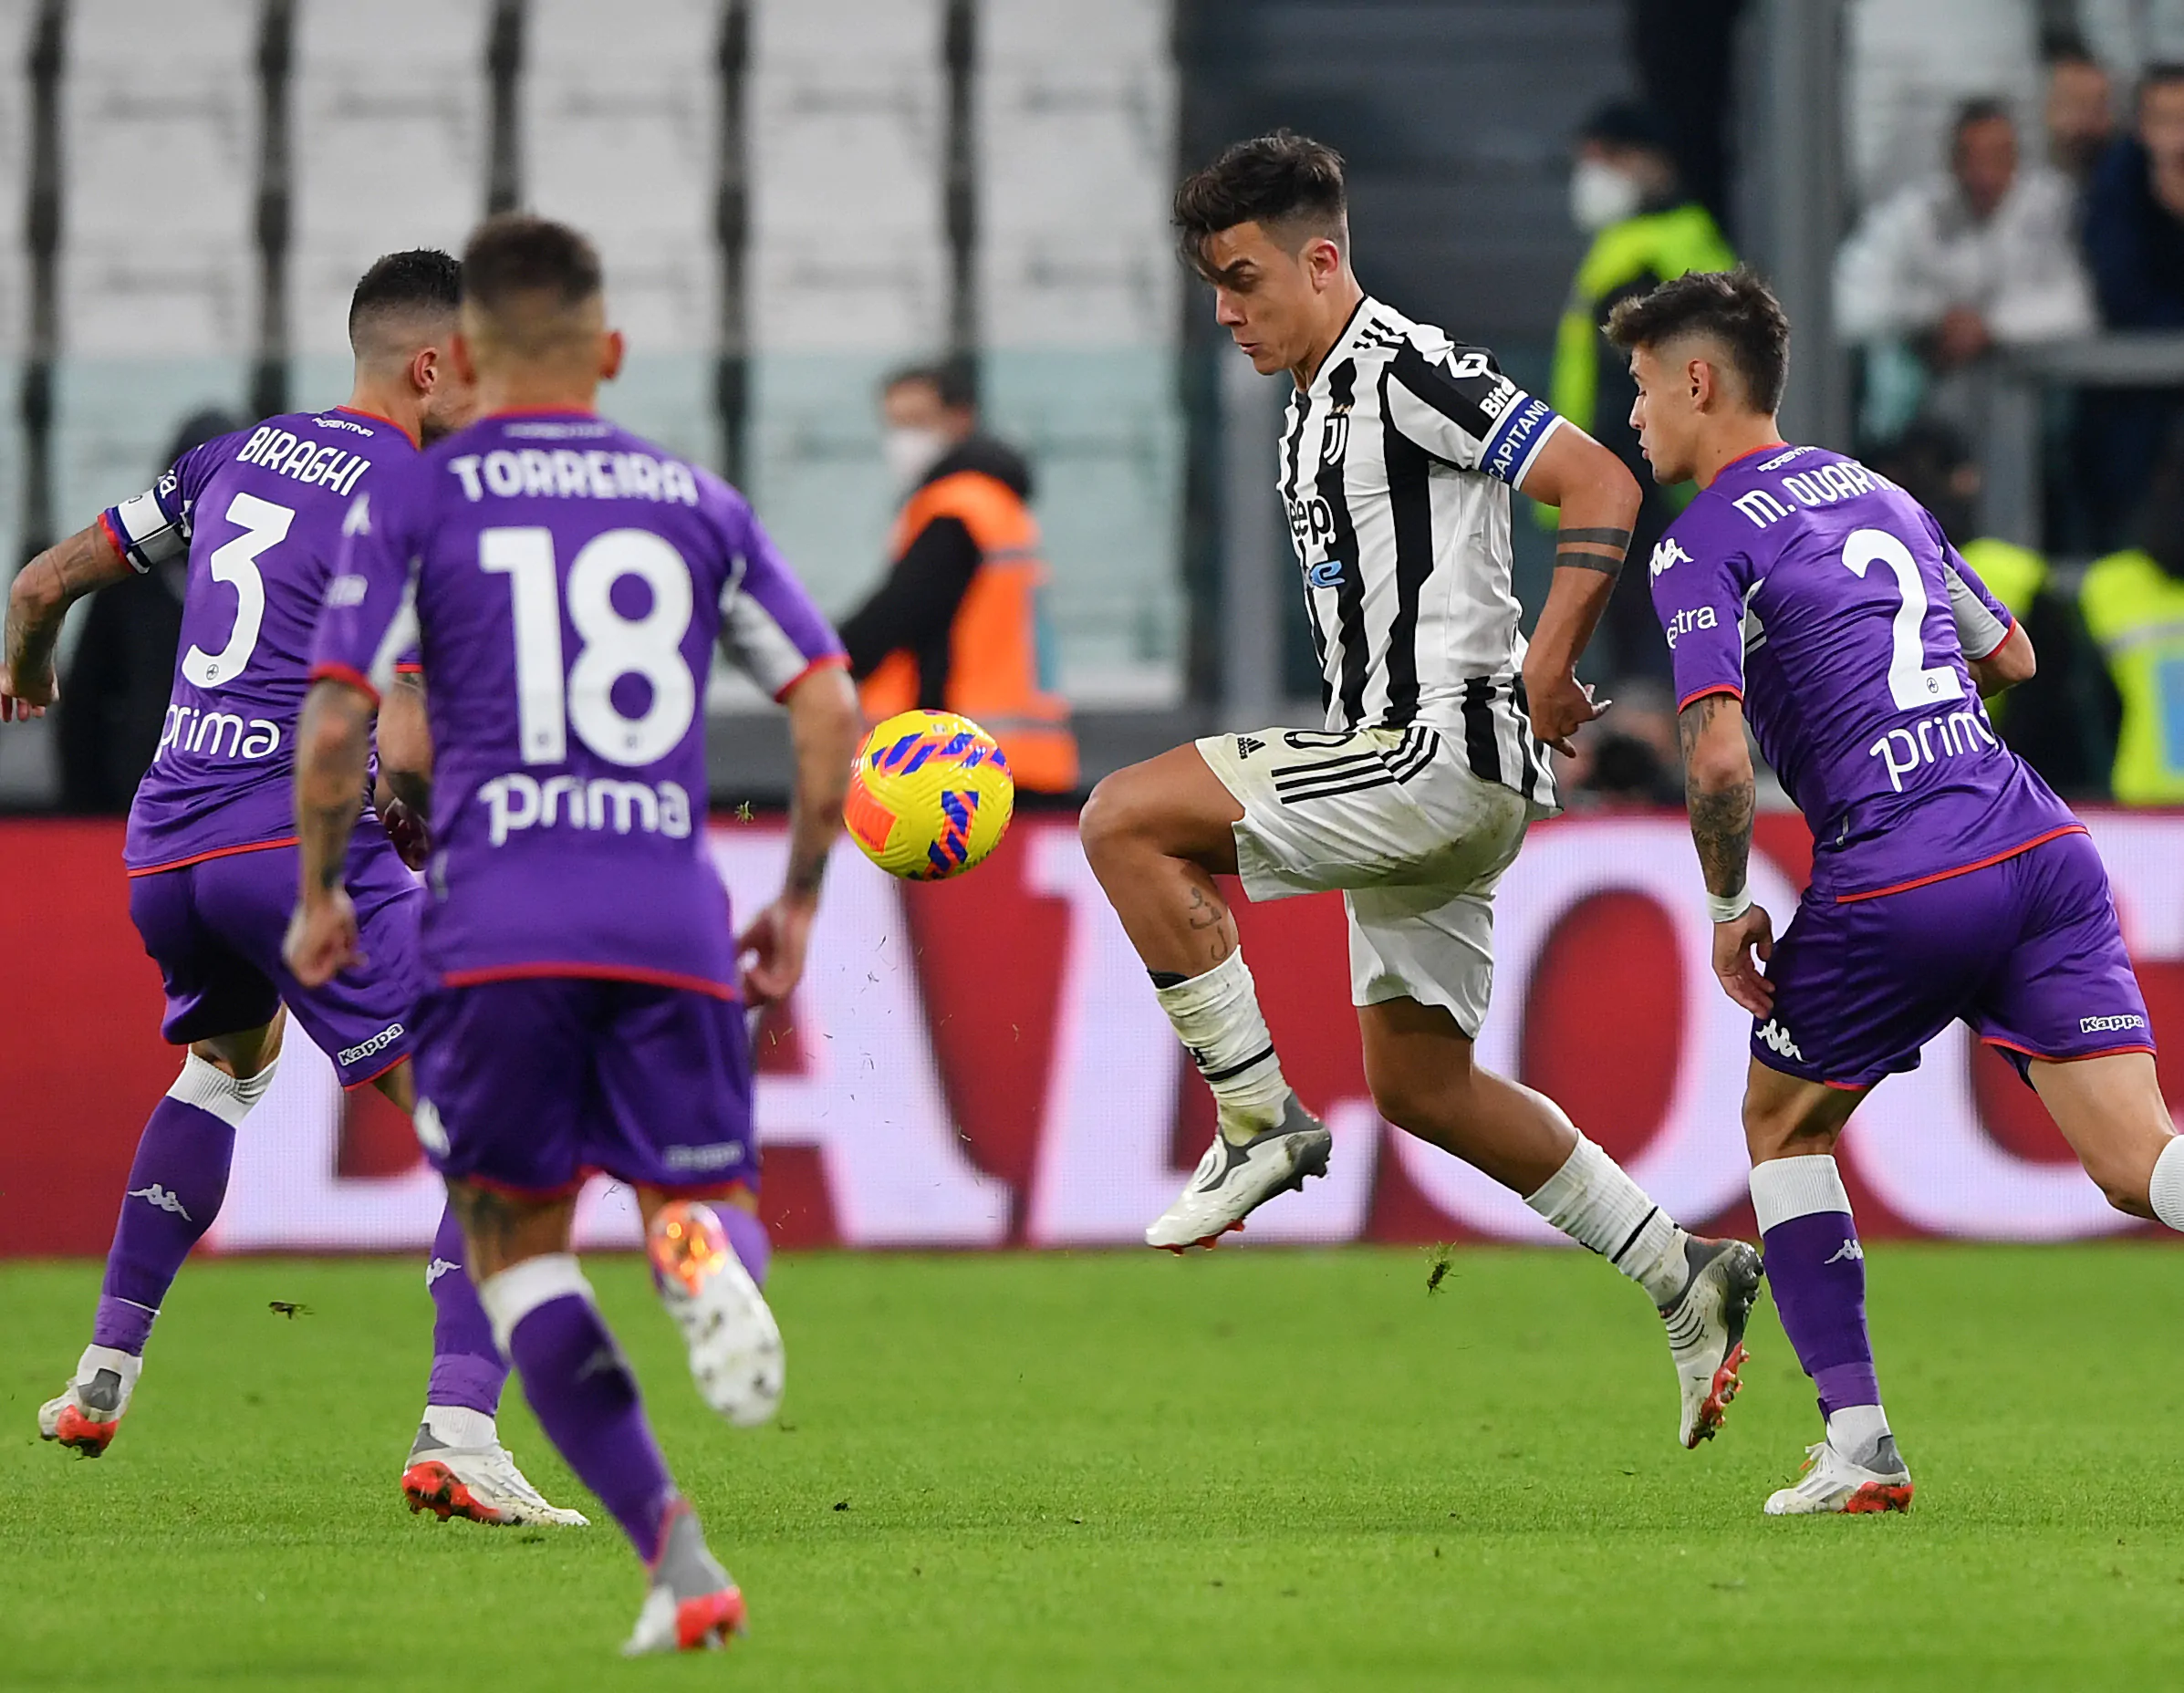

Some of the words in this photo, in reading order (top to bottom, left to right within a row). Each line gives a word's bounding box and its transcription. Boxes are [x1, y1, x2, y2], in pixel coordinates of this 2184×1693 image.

[236, 426, 370, 496] BIRAGHI
[448, 448, 699, 506] TORREIRA
[1288, 498, 1332, 545] eep
[1732, 490, 1797, 529] M.
[182, 493, 295, 688] 3
[1841, 528, 1966, 711] 2
[479, 526, 695, 766] 18
[153, 703, 280, 763] prima
[1869, 708, 1999, 793] prim
[477, 773, 692, 847] prima
[338, 1023, 404, 1066] Kappa
[2080, 1014, 2145, 1033] Kappa
